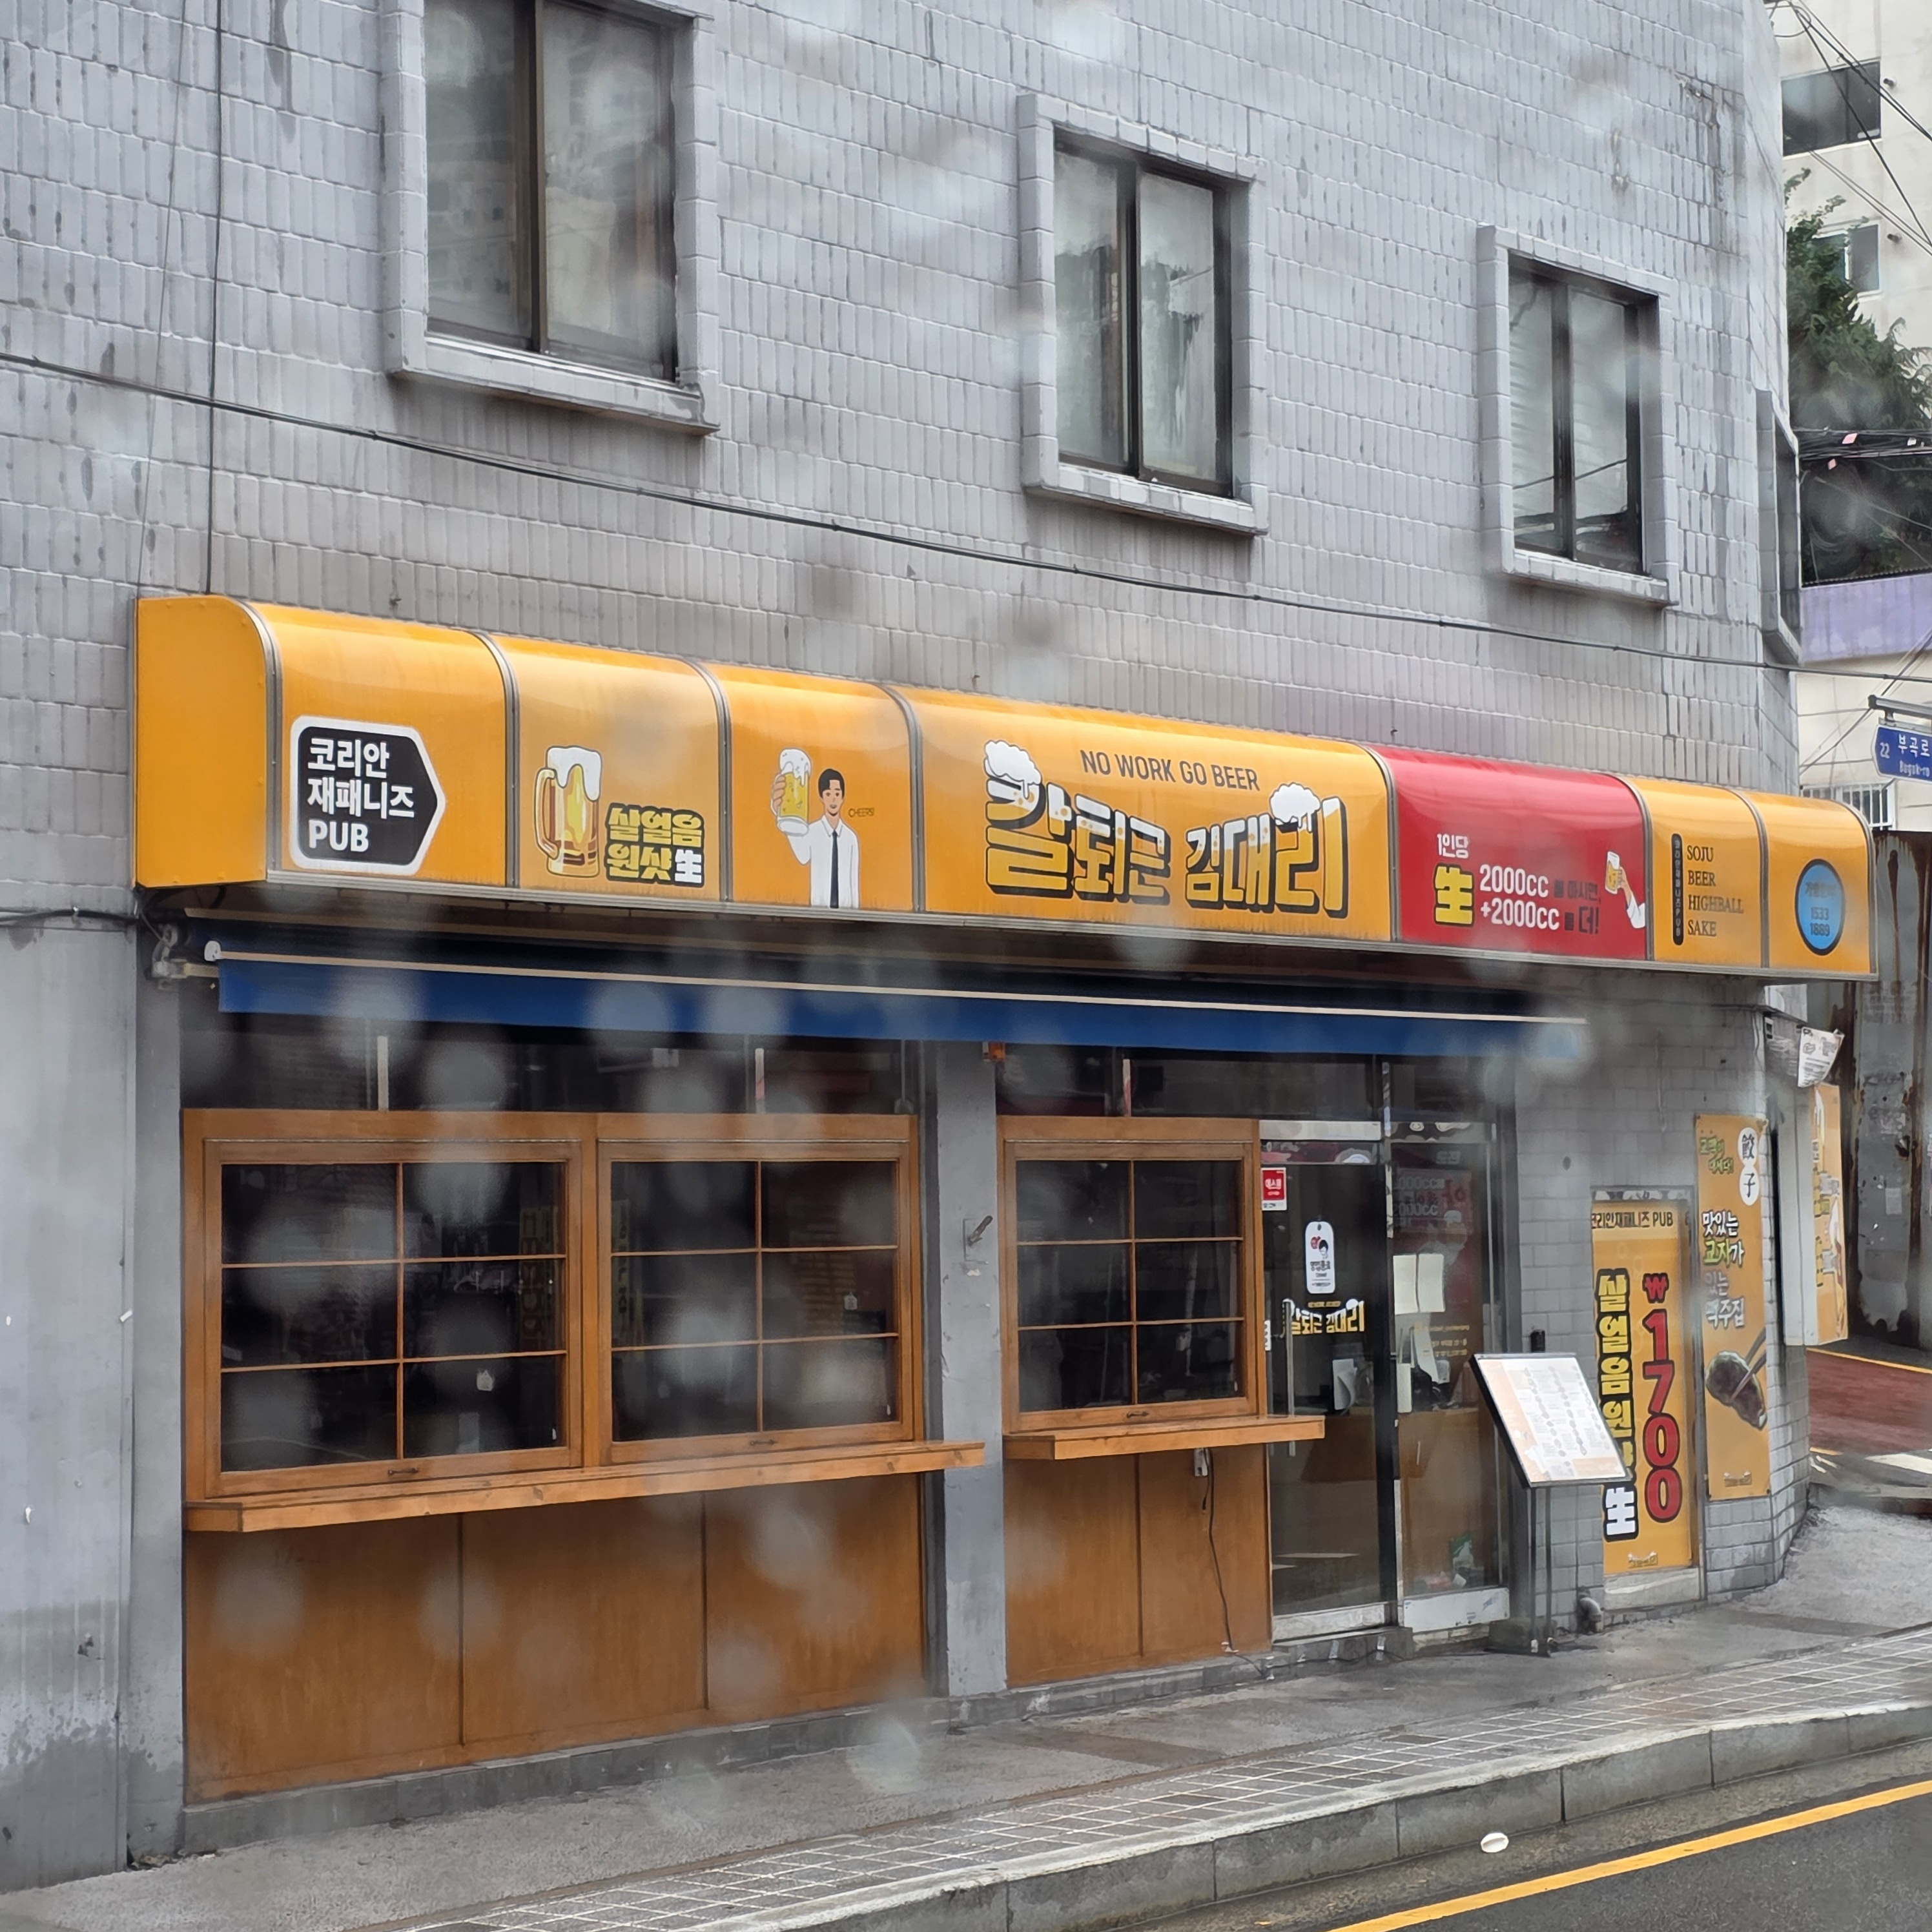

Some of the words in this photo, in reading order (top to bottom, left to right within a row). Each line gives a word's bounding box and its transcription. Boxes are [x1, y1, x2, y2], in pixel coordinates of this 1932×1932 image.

[308, 737, 389, 778] 코리안
[1880, 742, 1890, 759] 22
[1080, 750, 1111, 775] NO
[1115, 754, 1176, 783] WORK
[1179, 761, 1207, 785] GO
[1211, 765, 1260, 791] BEER
[307, 777, 415, 819] 재패니즈
[308, 819, 369, 853] PUB
[608, 808, 702, 847] 살얼음
[985, 752, 1171, 905] 칼퇴근
[1186, 785, 1350, 917] 김대리
[1687, 845, 1714, 862] SOJU
[1688, 870, 1716, 887] BEER
[1434, 865, 1473, 925] 生
[1688, 894, 1744, 914] HIGHBALL
[1687, 920, 1716, 936] SAKE
[1652, 1211, 1674, 1227] PUB
[1703, 1211, 1738, 1237] 맛있는
[1703, 1238, 1745, 1266] 교자가
[1326, 1299, 1364, 1333] 김대리
